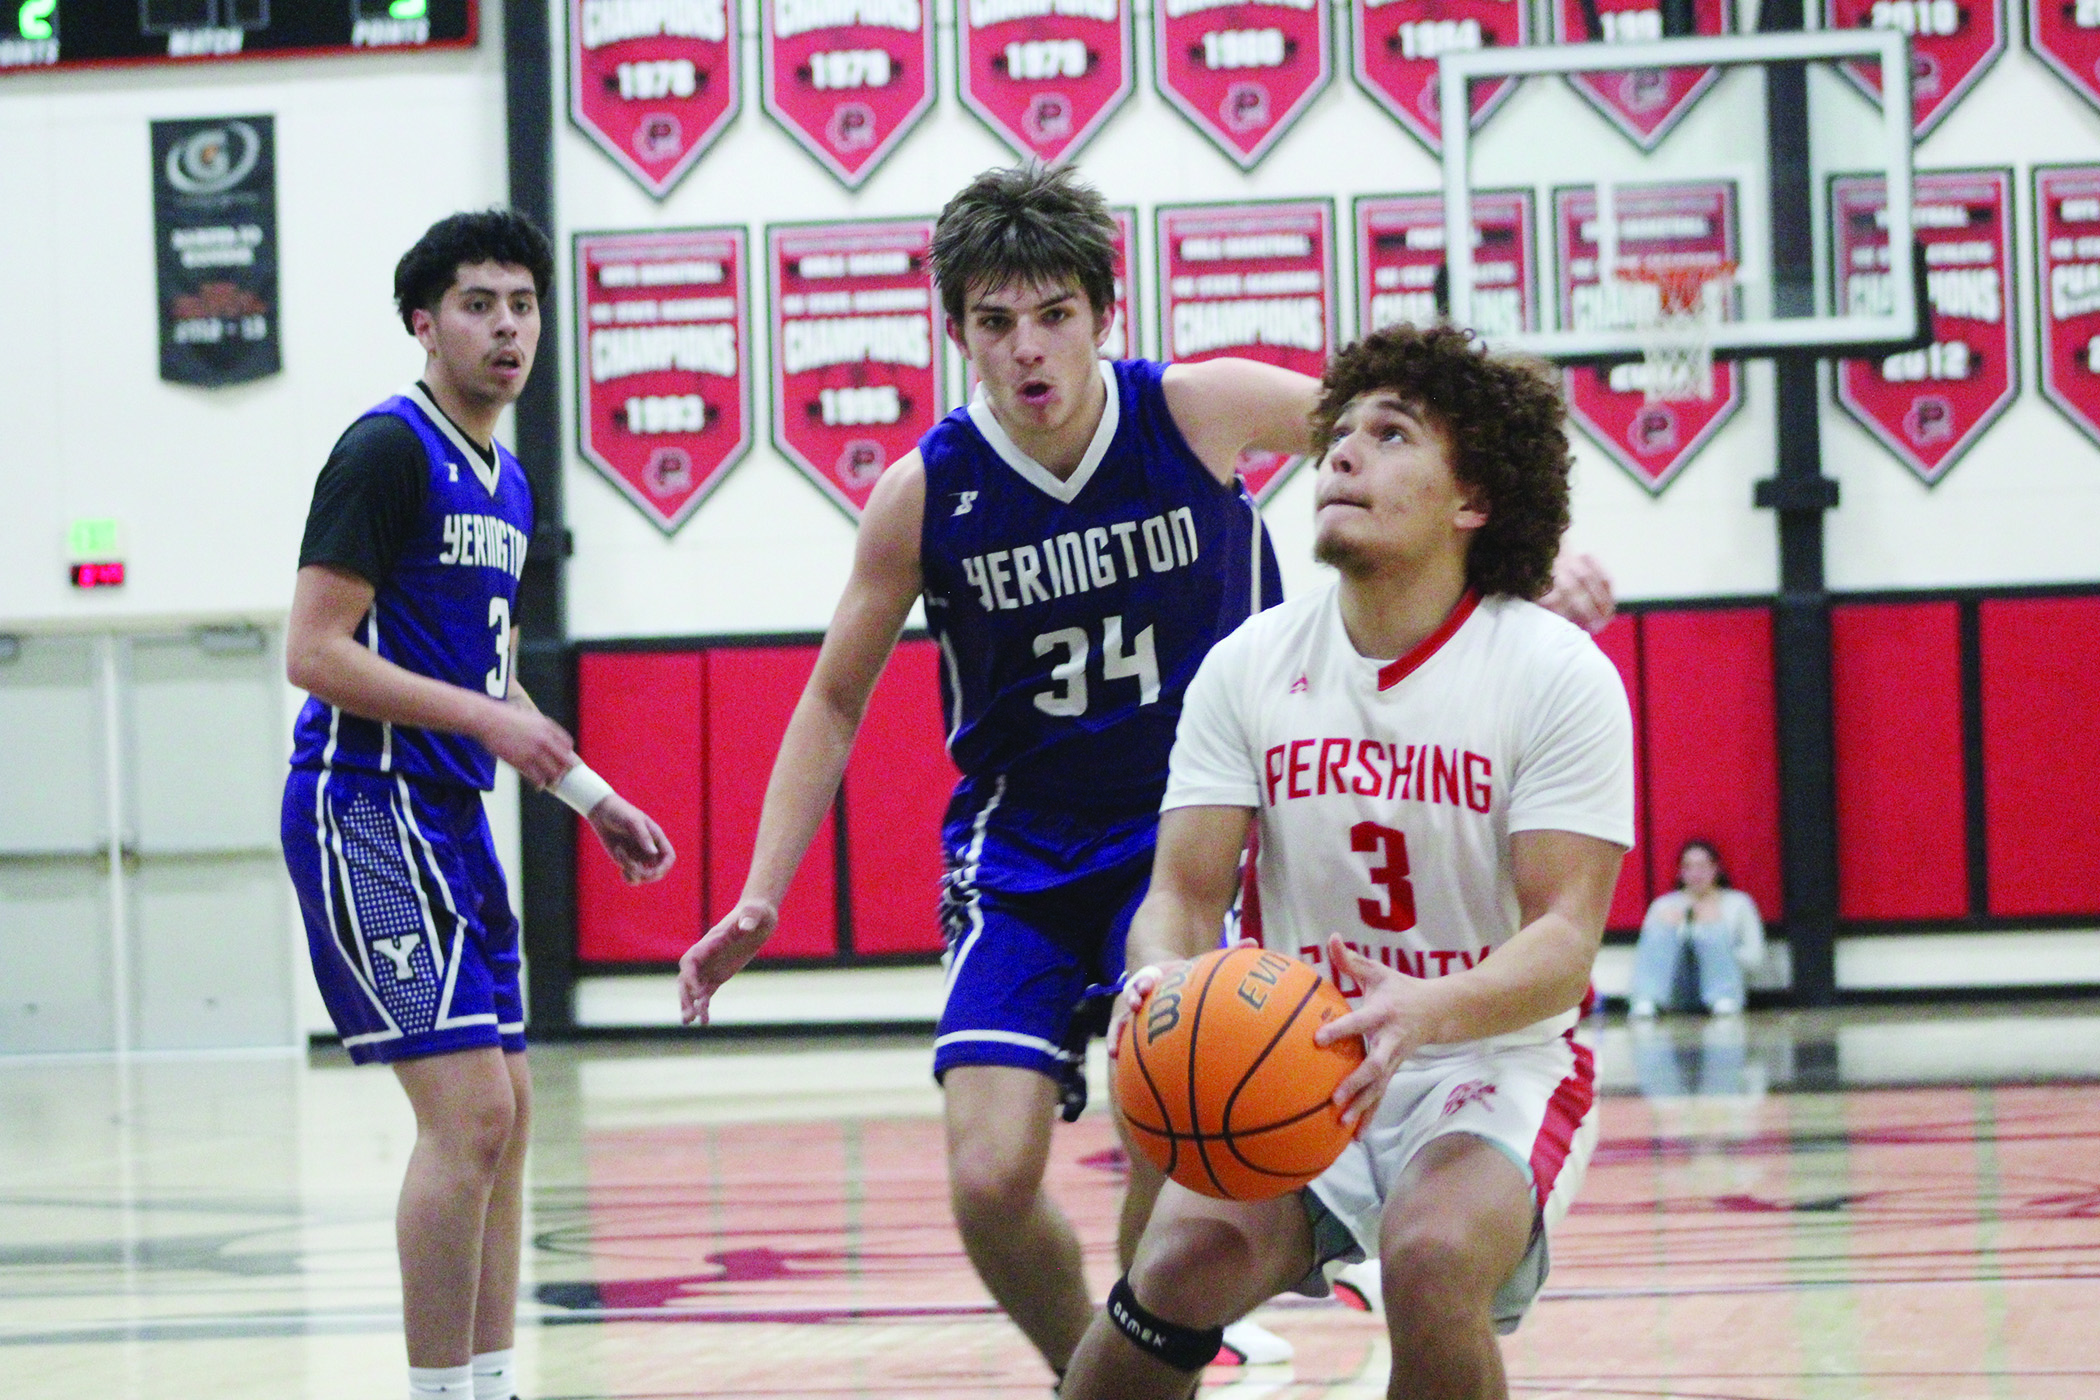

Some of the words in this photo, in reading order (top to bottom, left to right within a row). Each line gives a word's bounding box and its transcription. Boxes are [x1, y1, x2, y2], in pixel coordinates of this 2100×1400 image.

[168, 28, 245, 56] MATCH
[591, 323, 737, 383] CHAMPIONS
[784, 314, 931, 375] CHAMPIONS
[1174, 296, 1323, 358] CHAMPIONS
[962, 505, 1199, 612] YERINGTON
[1033, 615, 1162, 717] 34
[1266, 737, 1493, 814] PERSHING
[1350, 820, 1417, 932] 3
[372, 938, 421, 979] Y
